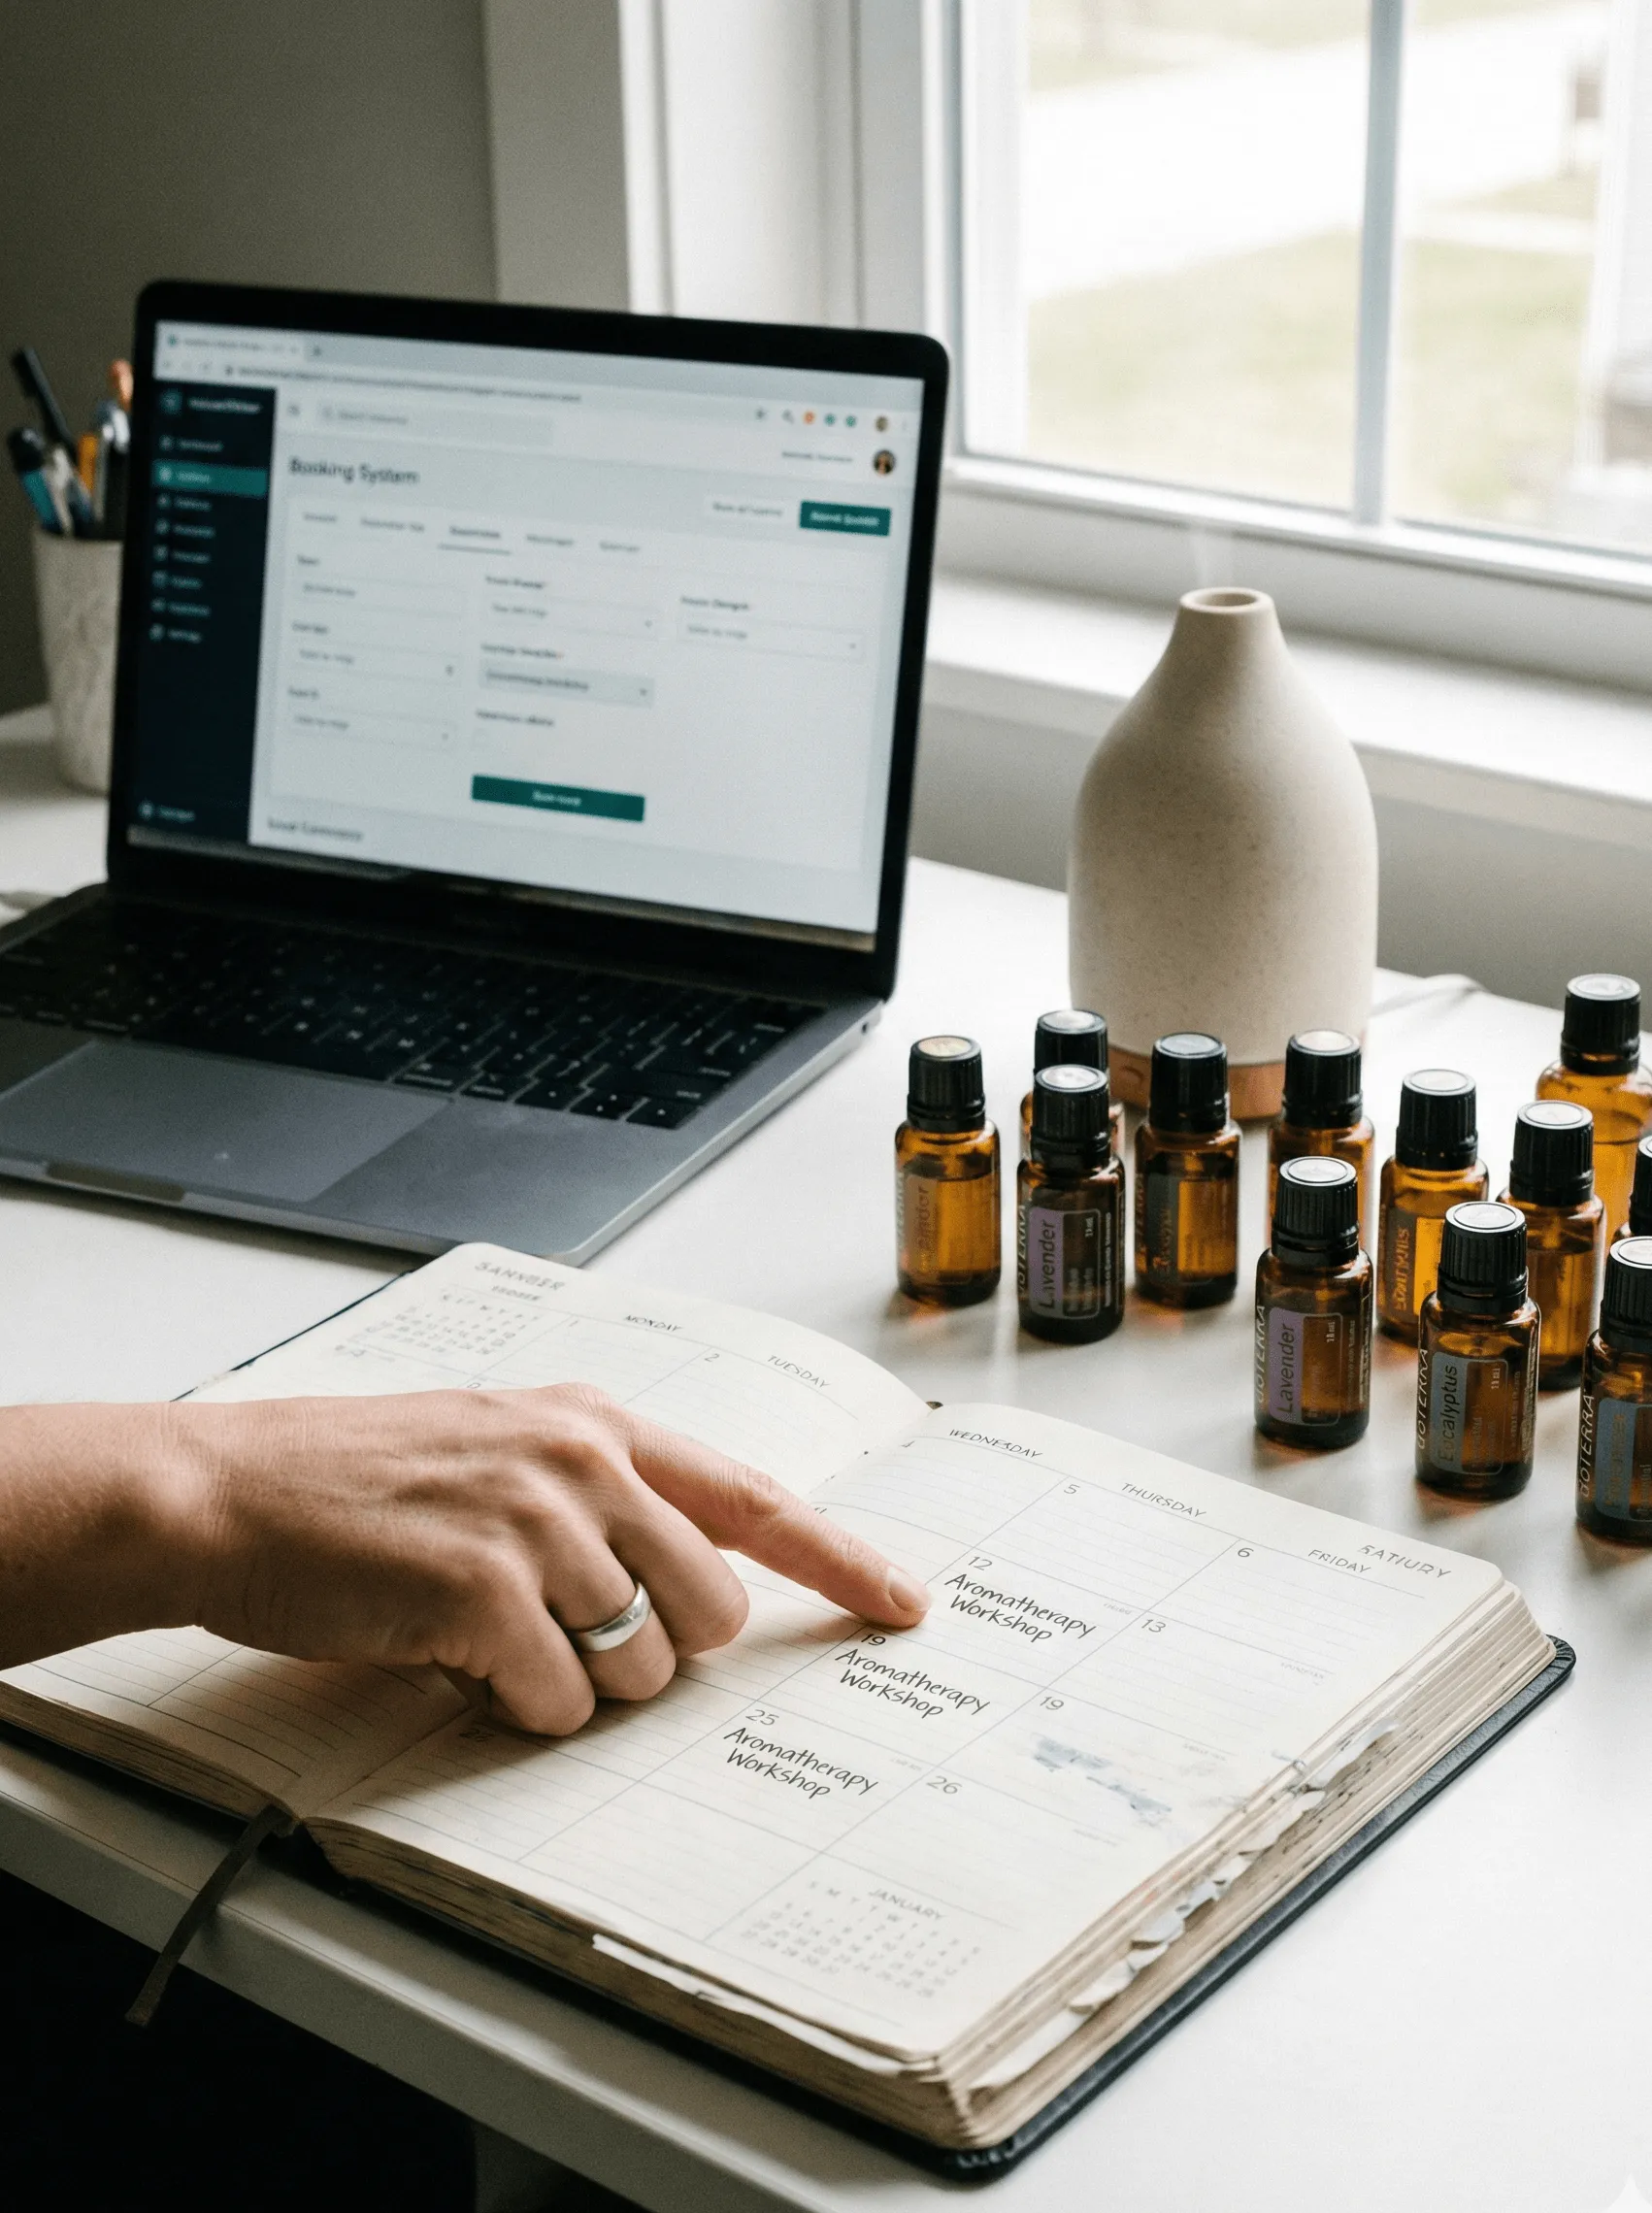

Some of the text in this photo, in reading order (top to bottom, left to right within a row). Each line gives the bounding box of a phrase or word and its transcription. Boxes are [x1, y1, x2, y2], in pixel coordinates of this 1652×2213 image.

[289, 457, 419, 485] Booking System
[623, 1314, 682, 1333] MONDAY
[704, 1352, 720, 1363] 2
[767, 1354, 831, 1389] TUESDAY
[1276, 1323, 1295, 1413] Lavender
[1438, 1365, 1460, 1462] Eucalyptus
[948, 1428, 1042, 1459] WEDNESDAY
[1063, 1484, 1080, 1496] 5
[1121, 1482, 1206, 1519] THURSDAY
[968, 1555, 993, 1571] 12
[1237, 1546, 1254, 1559] 6
[1307, 1548, 1371, 1574] FRIDAY
[944, 1572, 1097, 1639] Aromatherapy
[950, 1595, 1053, 1642] Workshop
[860, 1633, 887, 1647] 19
[1141, 1618, 1167, 1634] 13
[835, 1648, 990, 1716] Aromatherapy
[840, 1668, 943, 1719] Workshop
[1039, 1695, 1065, 1711] 19
[745, 1708, 780, 1727] 25
[723, 1727, 878, 1796] Aromatherapy
[727, 1748, 831, 1800] Workshop
[926, 1774, 963, 1796] 26
